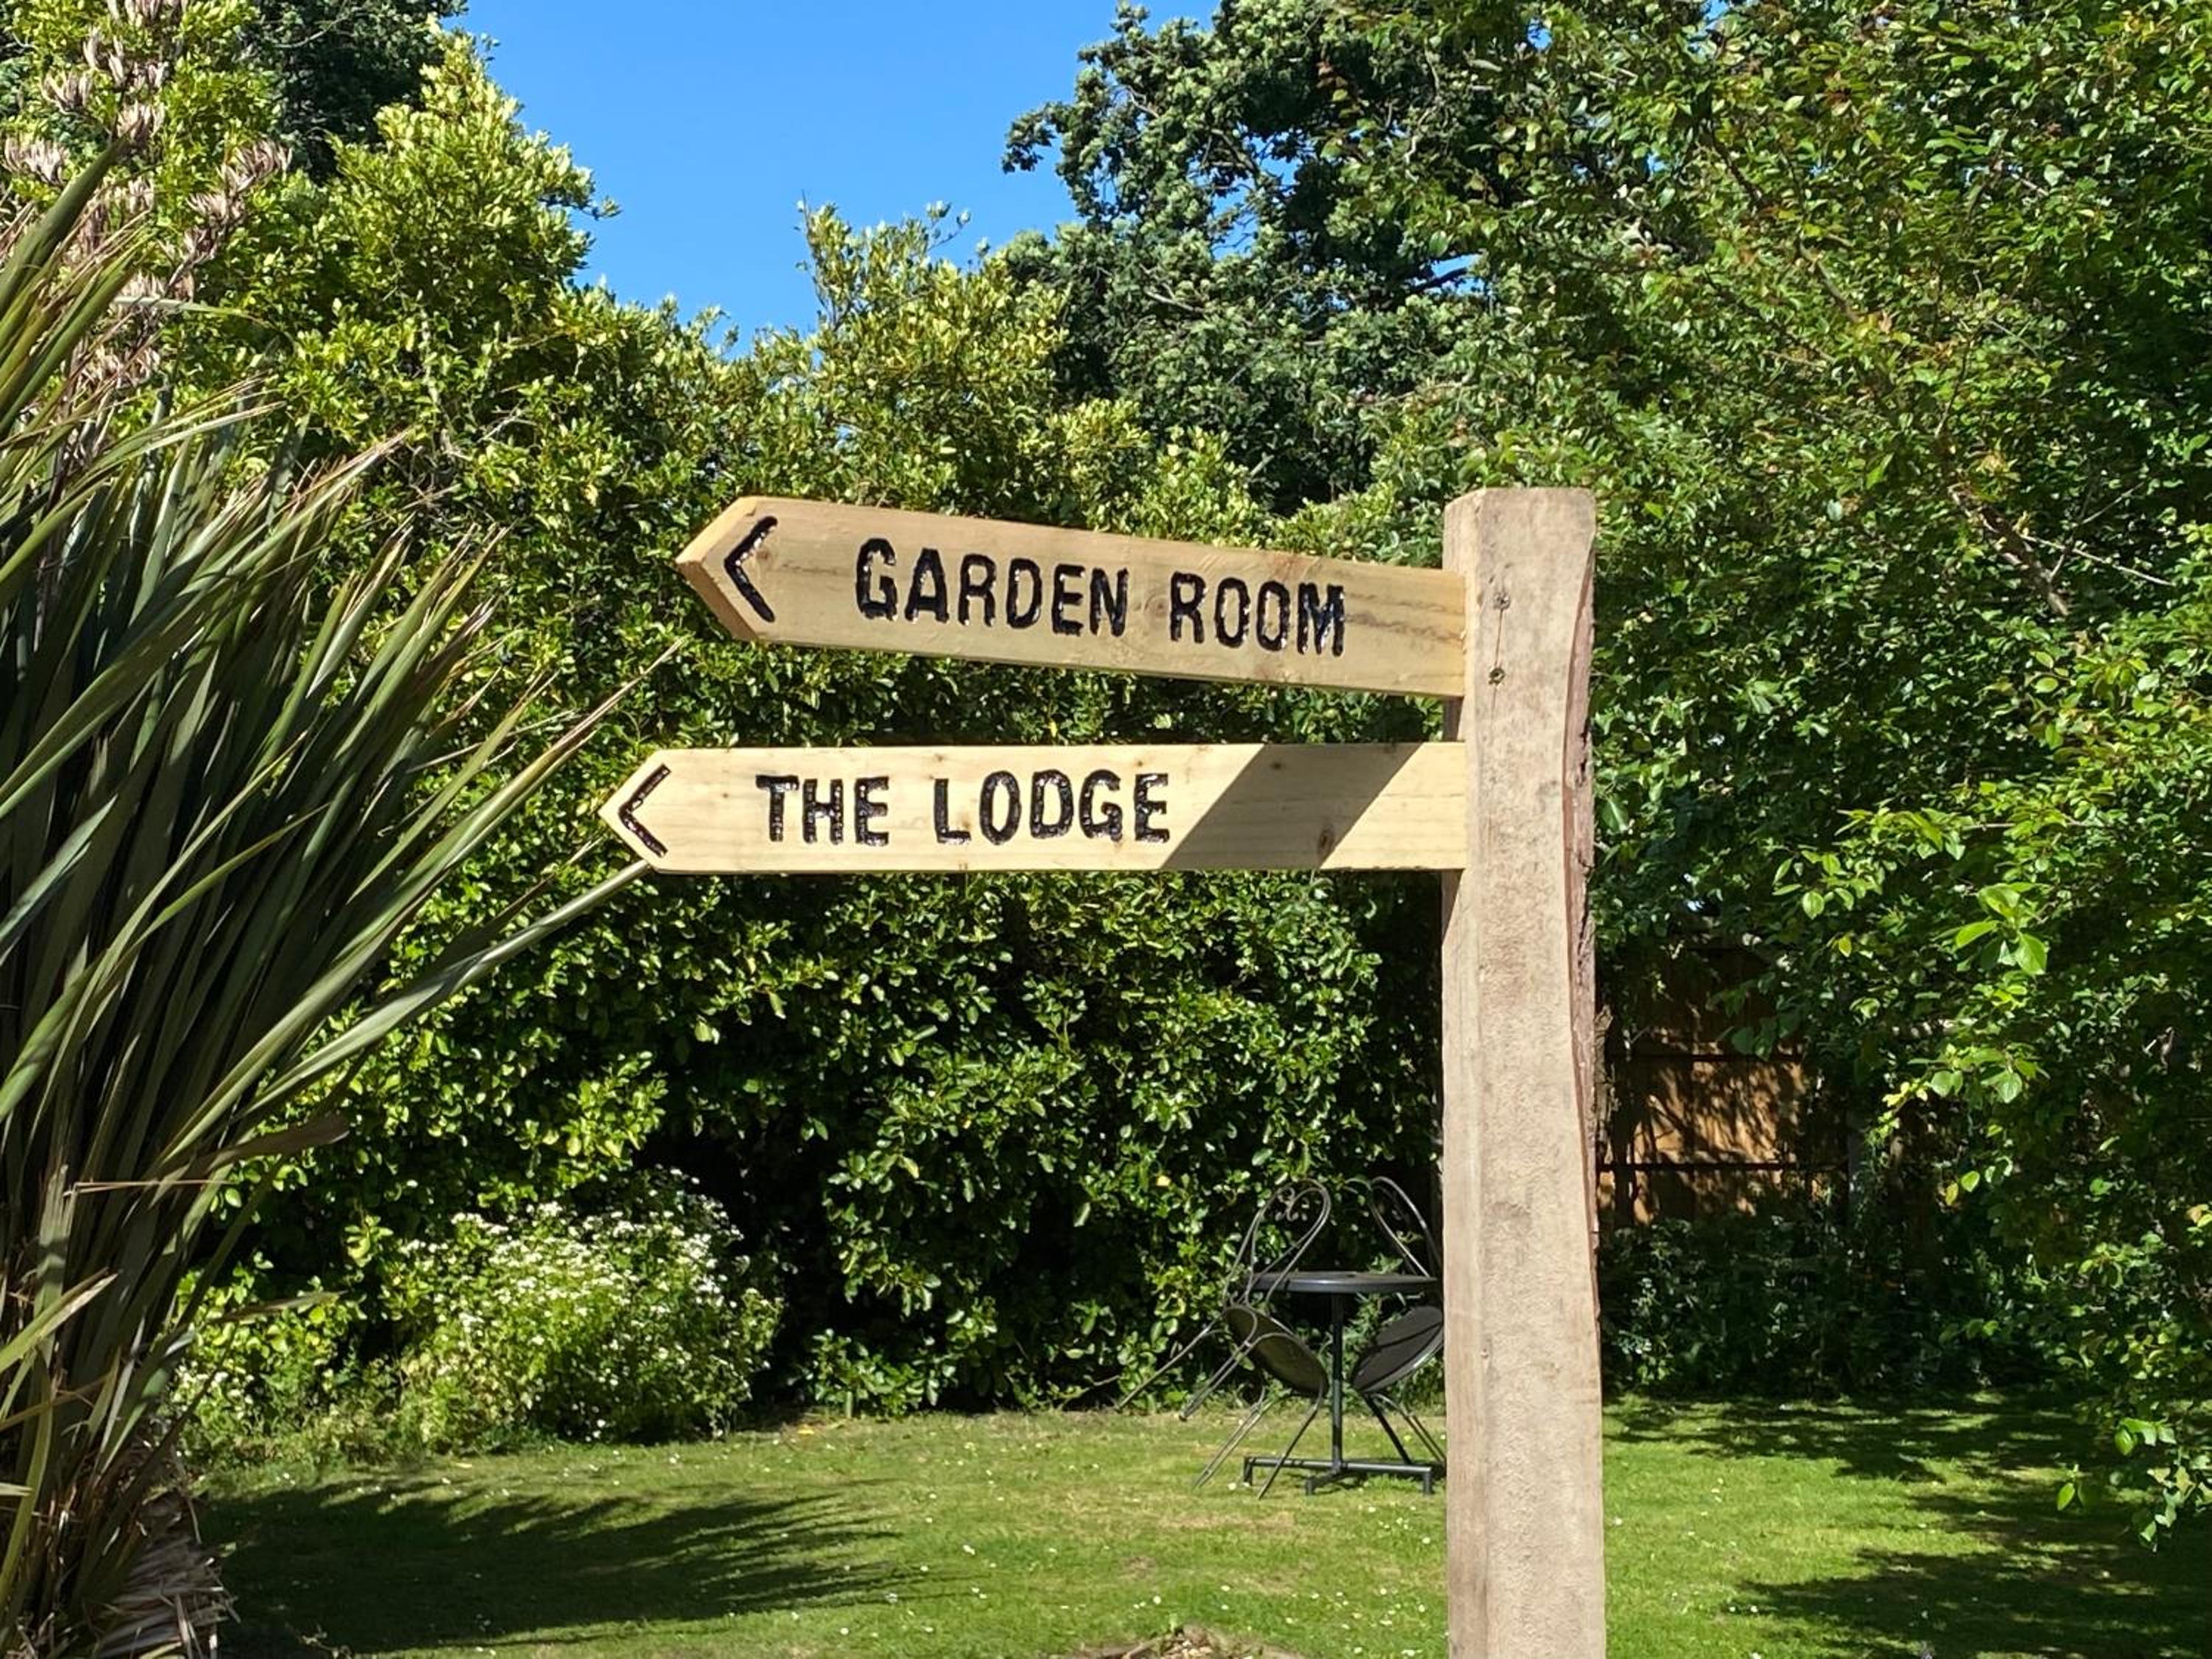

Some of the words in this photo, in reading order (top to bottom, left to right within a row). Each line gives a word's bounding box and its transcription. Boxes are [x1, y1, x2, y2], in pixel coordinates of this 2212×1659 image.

[855, 538, 1130, 638] GARDEN
[1169, 571, 1346, 657] ROOM
[755, 774, 890, 846] THE
[933, 769, 1171, 845] LODGE
